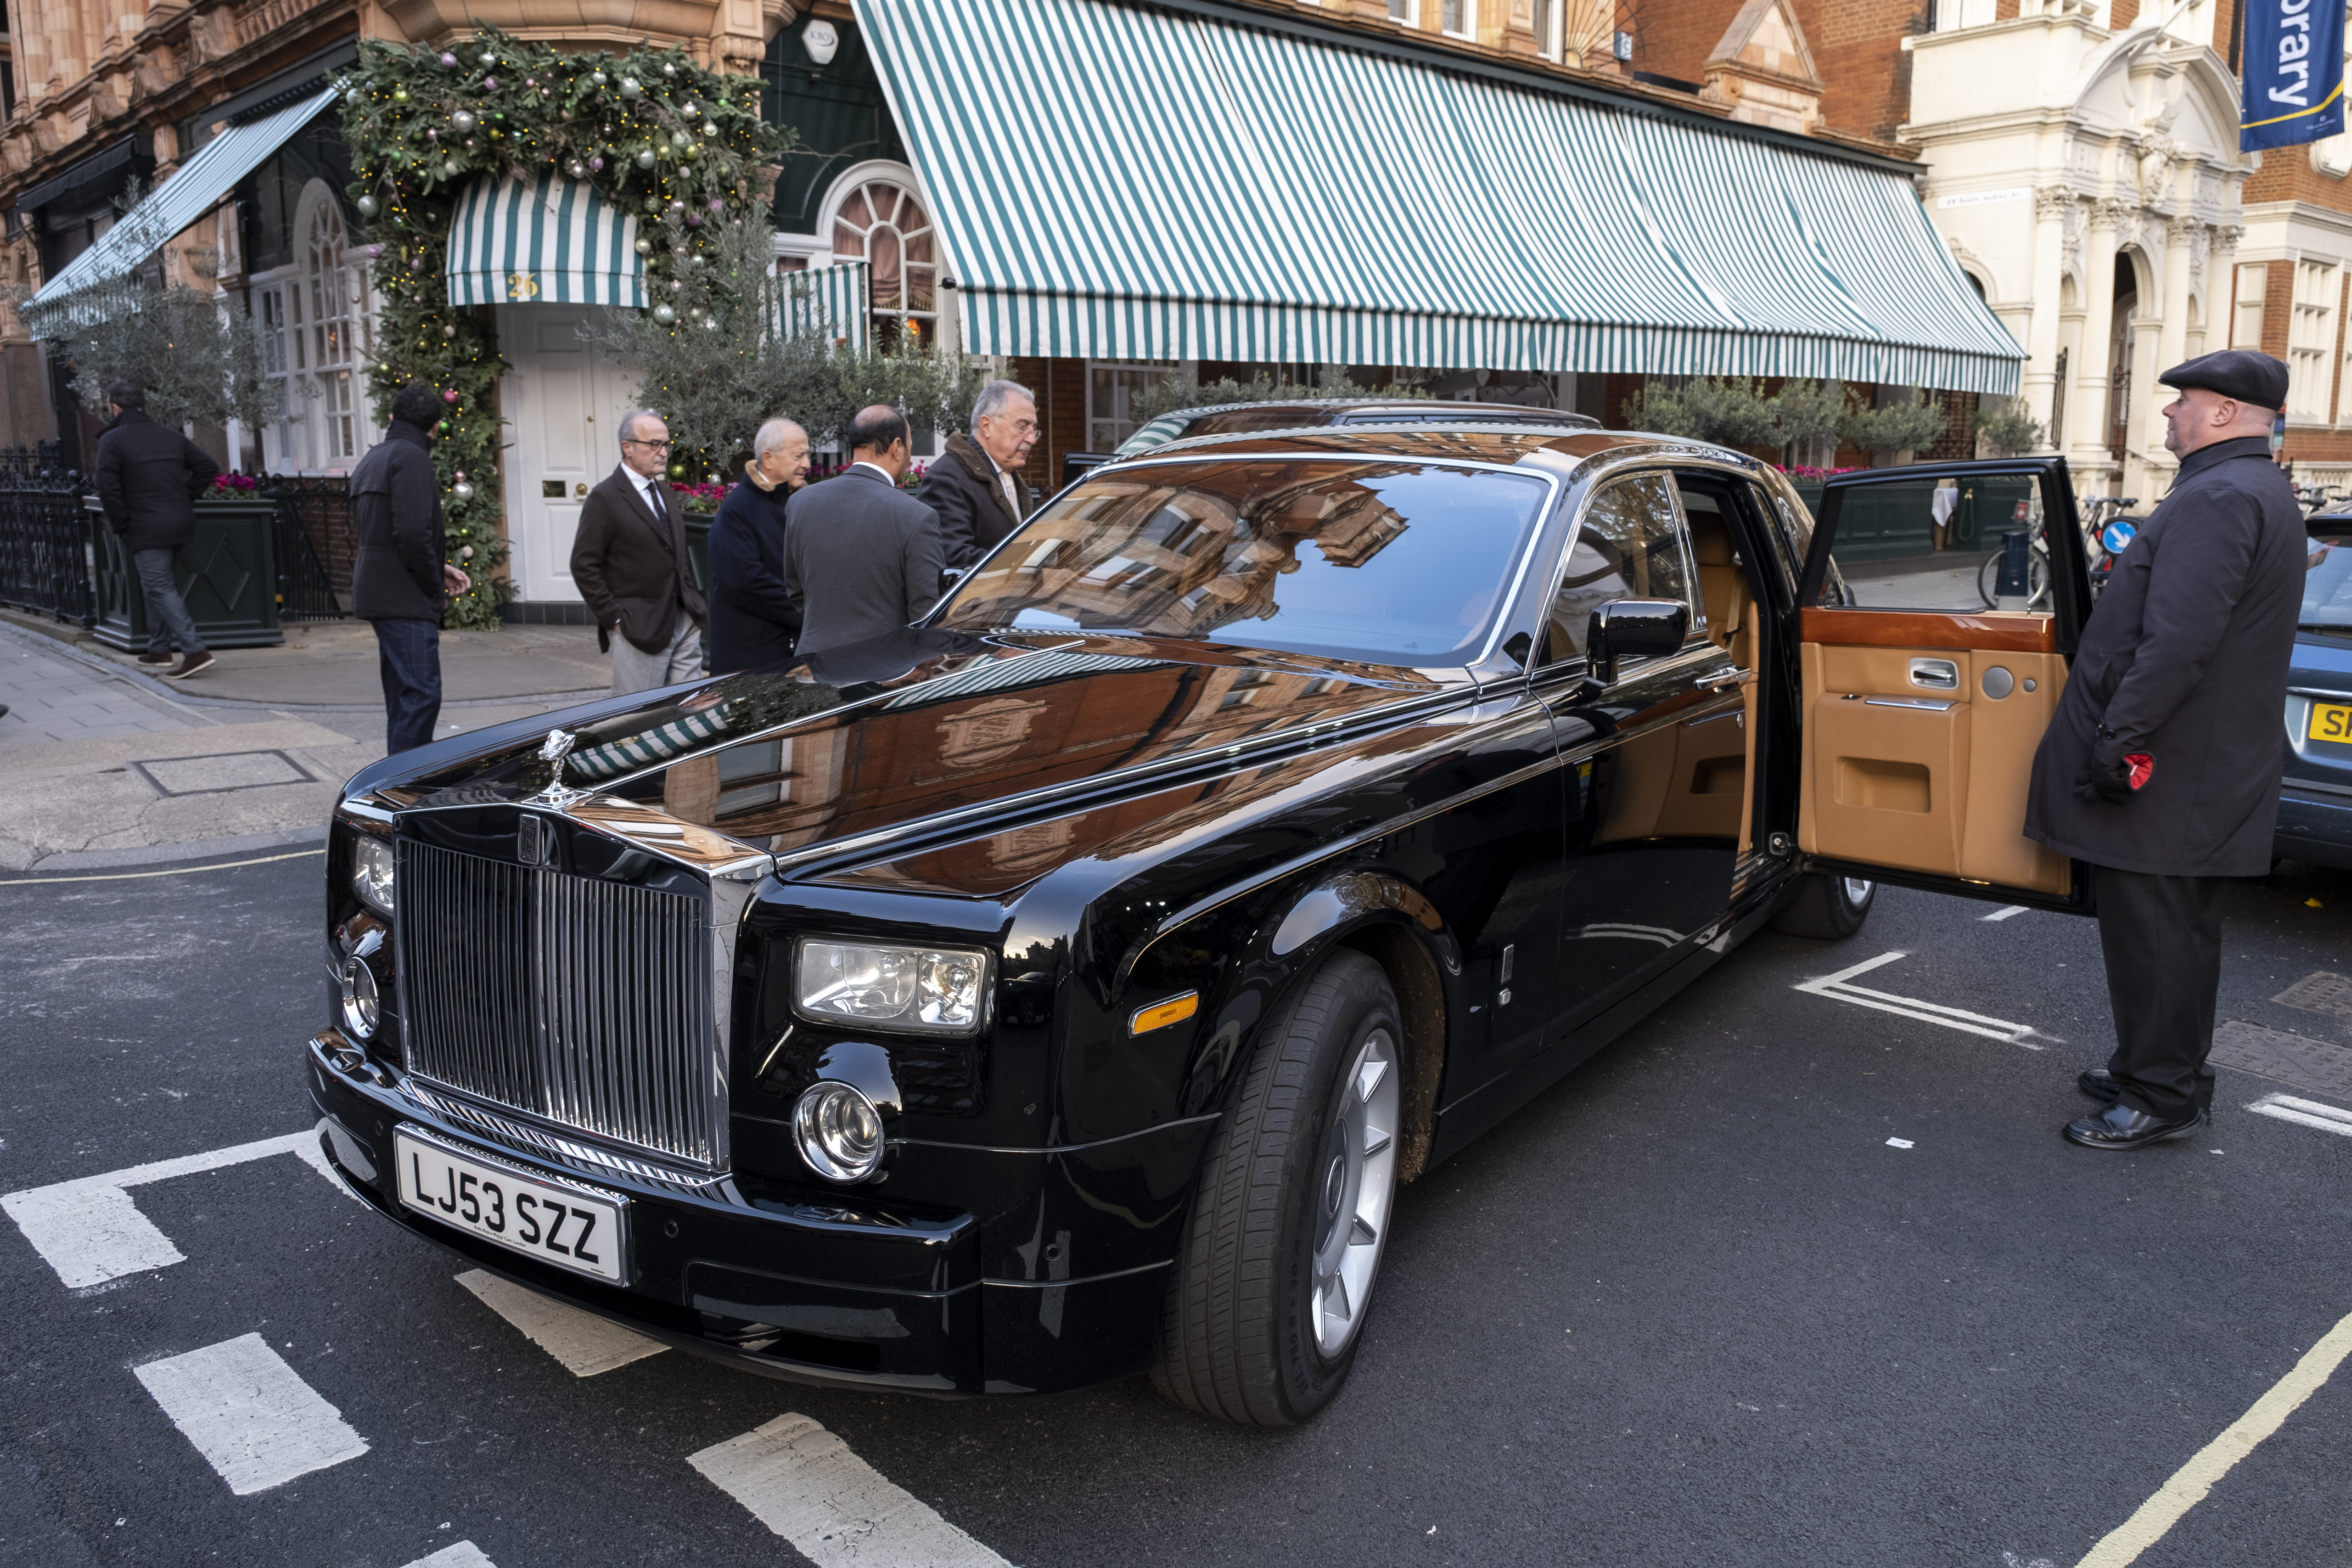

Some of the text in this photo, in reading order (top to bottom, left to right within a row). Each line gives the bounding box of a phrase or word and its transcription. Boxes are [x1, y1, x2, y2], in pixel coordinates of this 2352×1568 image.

[508, 273, 539, 298] 26
[2324, 710, 2352, 737] S
[522, 818, 537, 826] ROLLS
[414, 1152, 599, 1264] LJ53 SZZ
[513, 1239, 527, 1248] London
